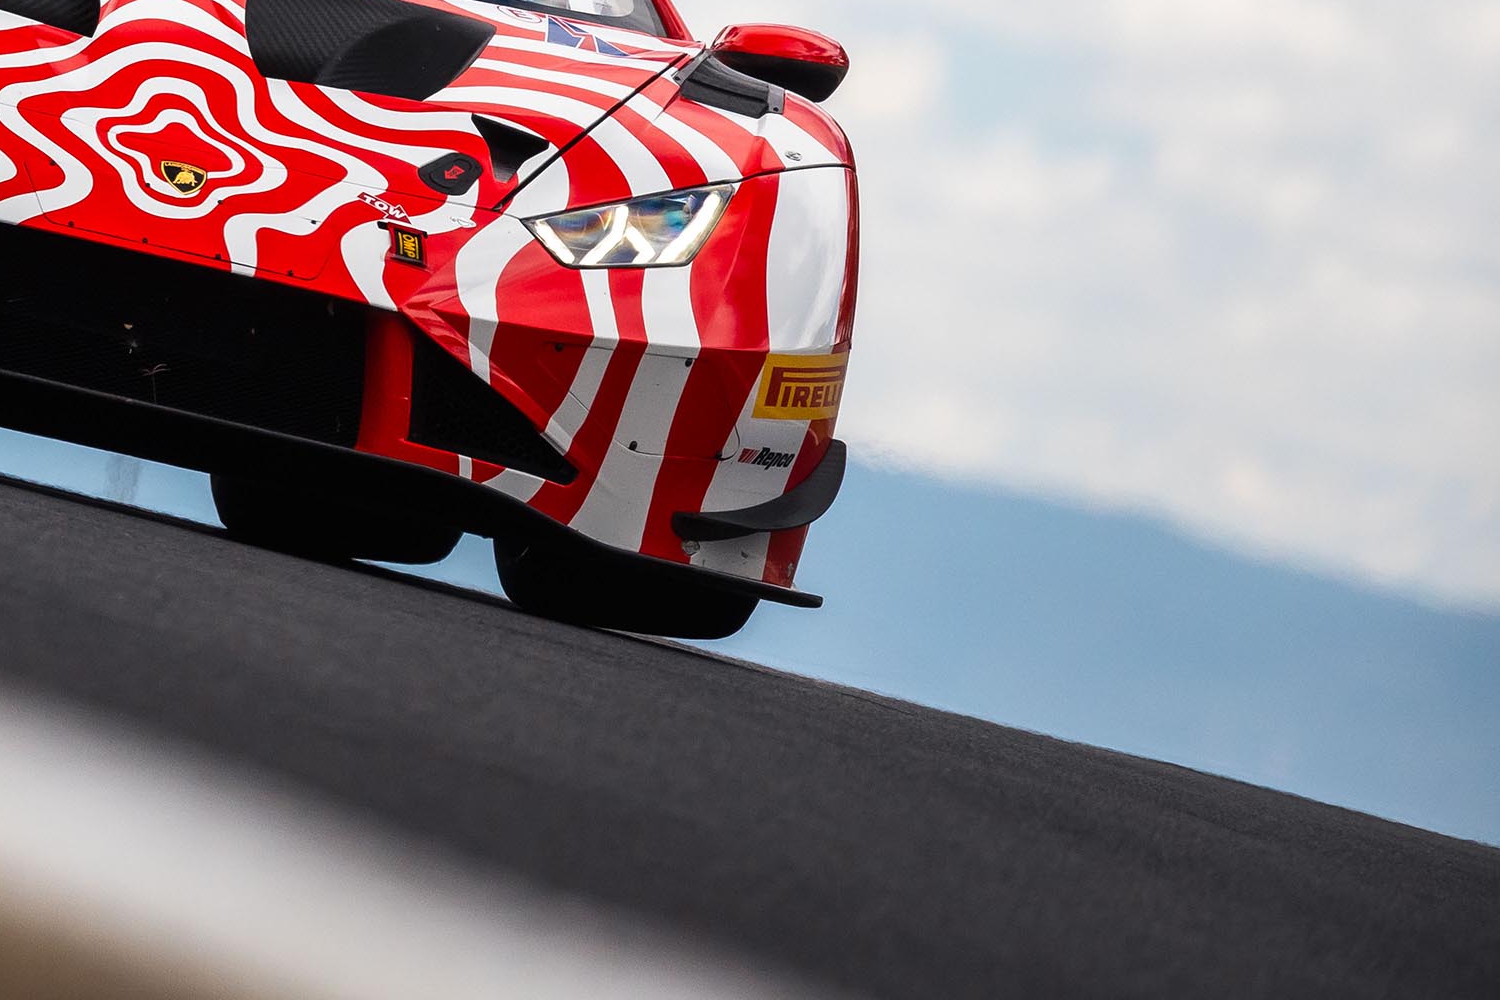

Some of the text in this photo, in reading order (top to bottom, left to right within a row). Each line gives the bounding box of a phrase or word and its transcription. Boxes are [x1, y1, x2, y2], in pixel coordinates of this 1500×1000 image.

[363, 194, 406, 219] TOW
[402, 233, 416, 258] OMP
[752, 447, 796, 470] Repco
